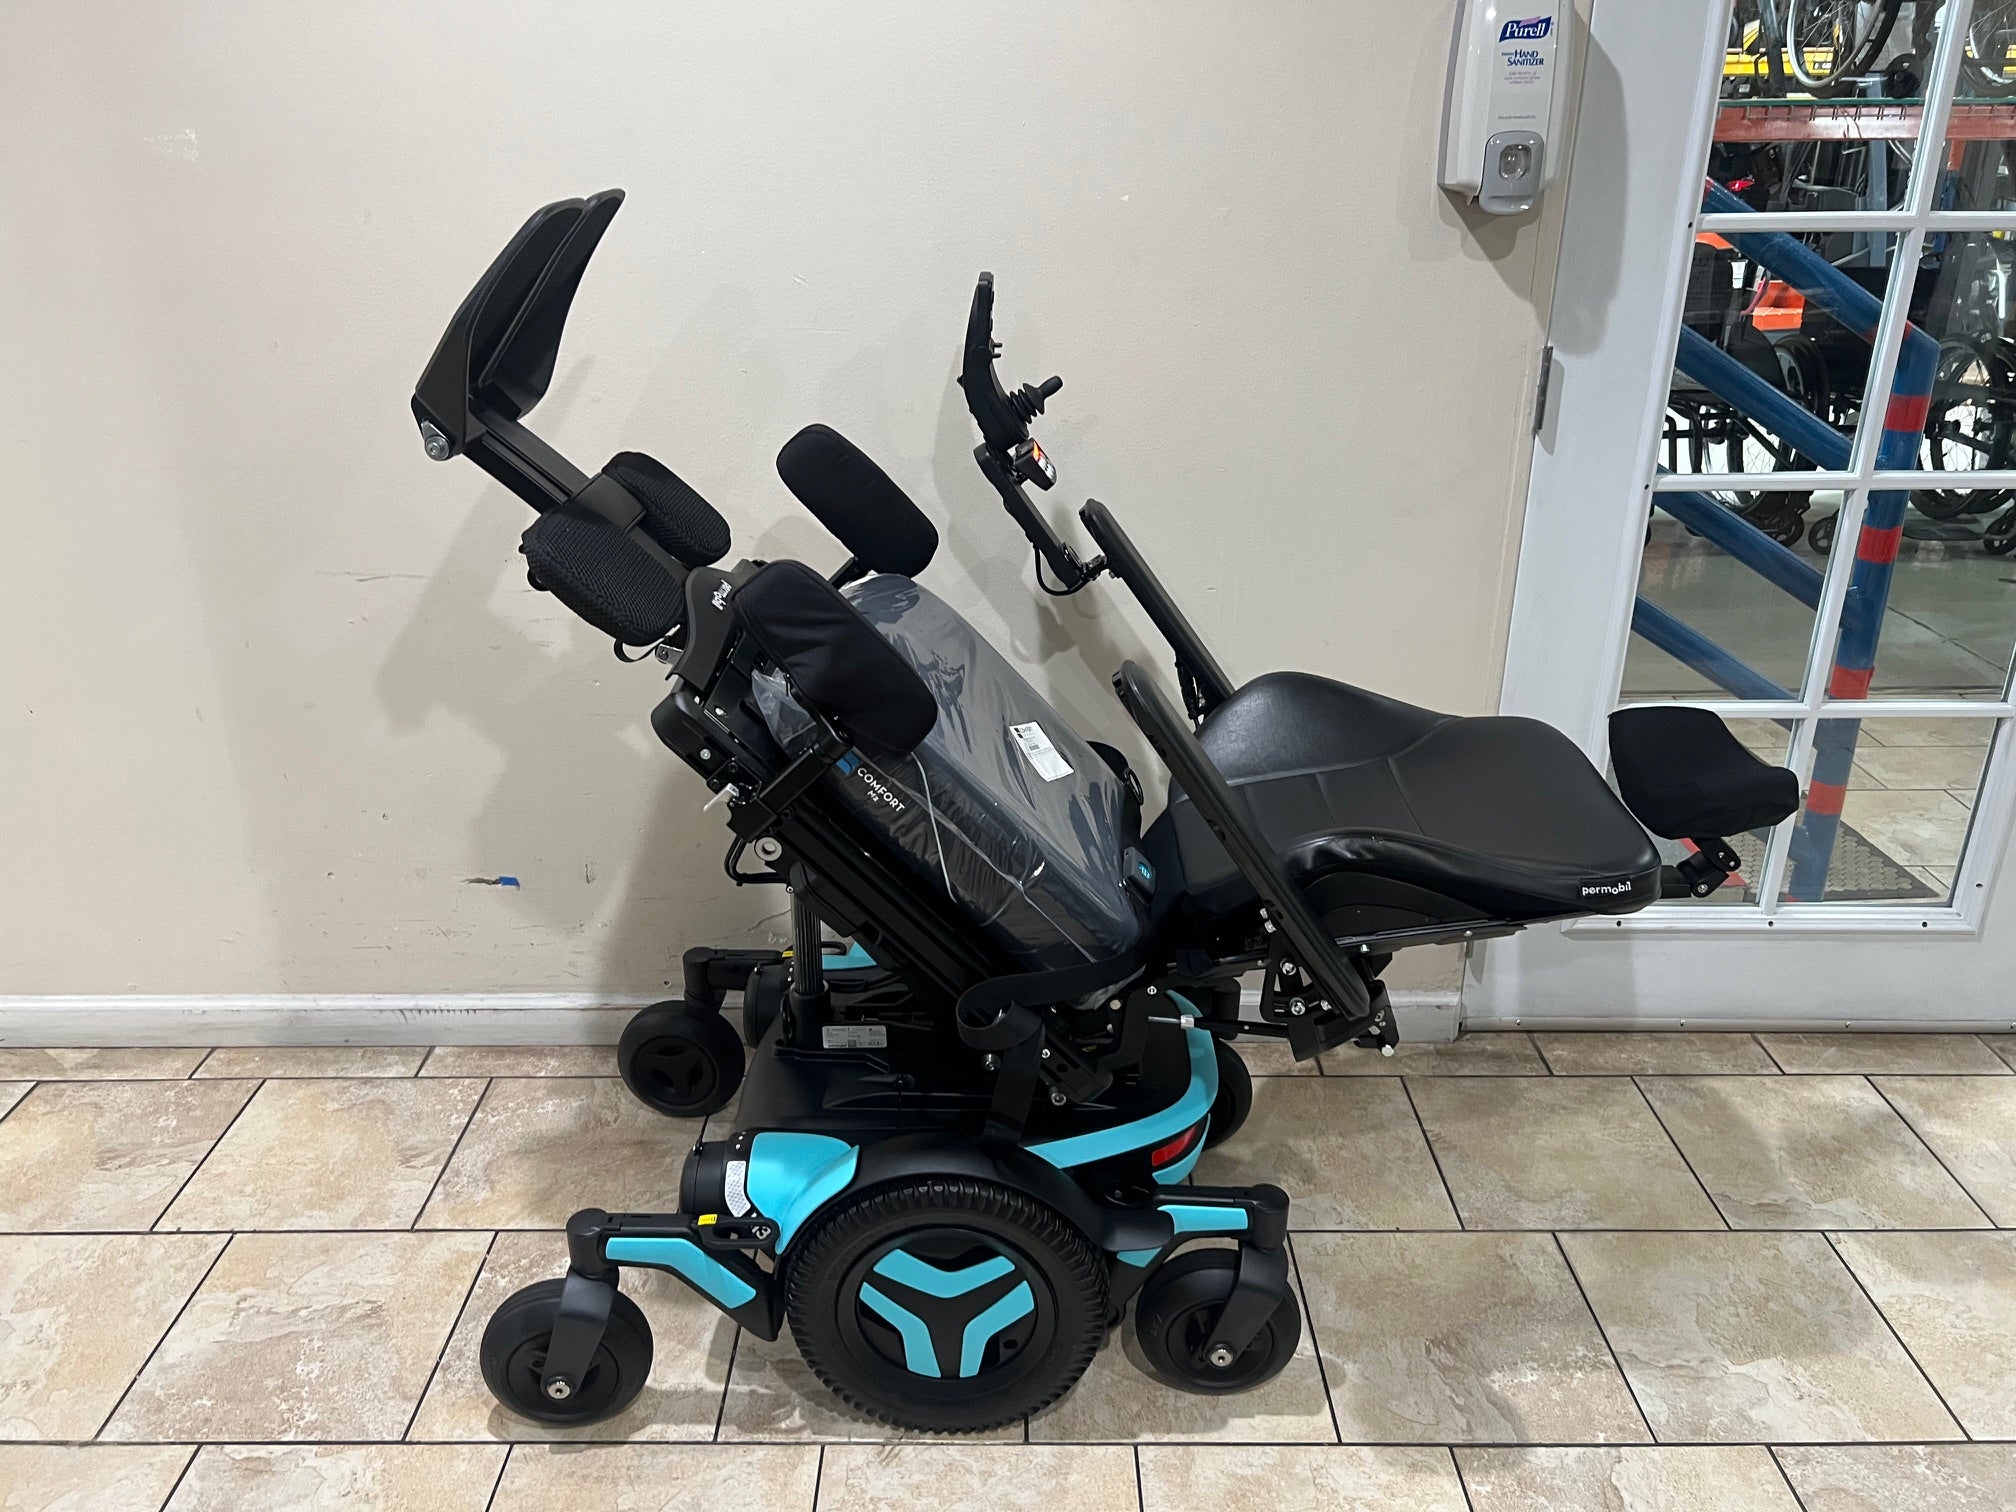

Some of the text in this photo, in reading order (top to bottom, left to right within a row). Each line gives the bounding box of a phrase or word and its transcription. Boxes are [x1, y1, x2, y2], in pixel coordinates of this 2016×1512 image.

[1505, 22, 1546, 38] Purell
[1514, 49, 1539, 58] HAND
[1507, 57, 1544, 67] SANITIZER
[857, 767, 905, 812] COMFORT
[1582, 881, 1632, 897] permobil
